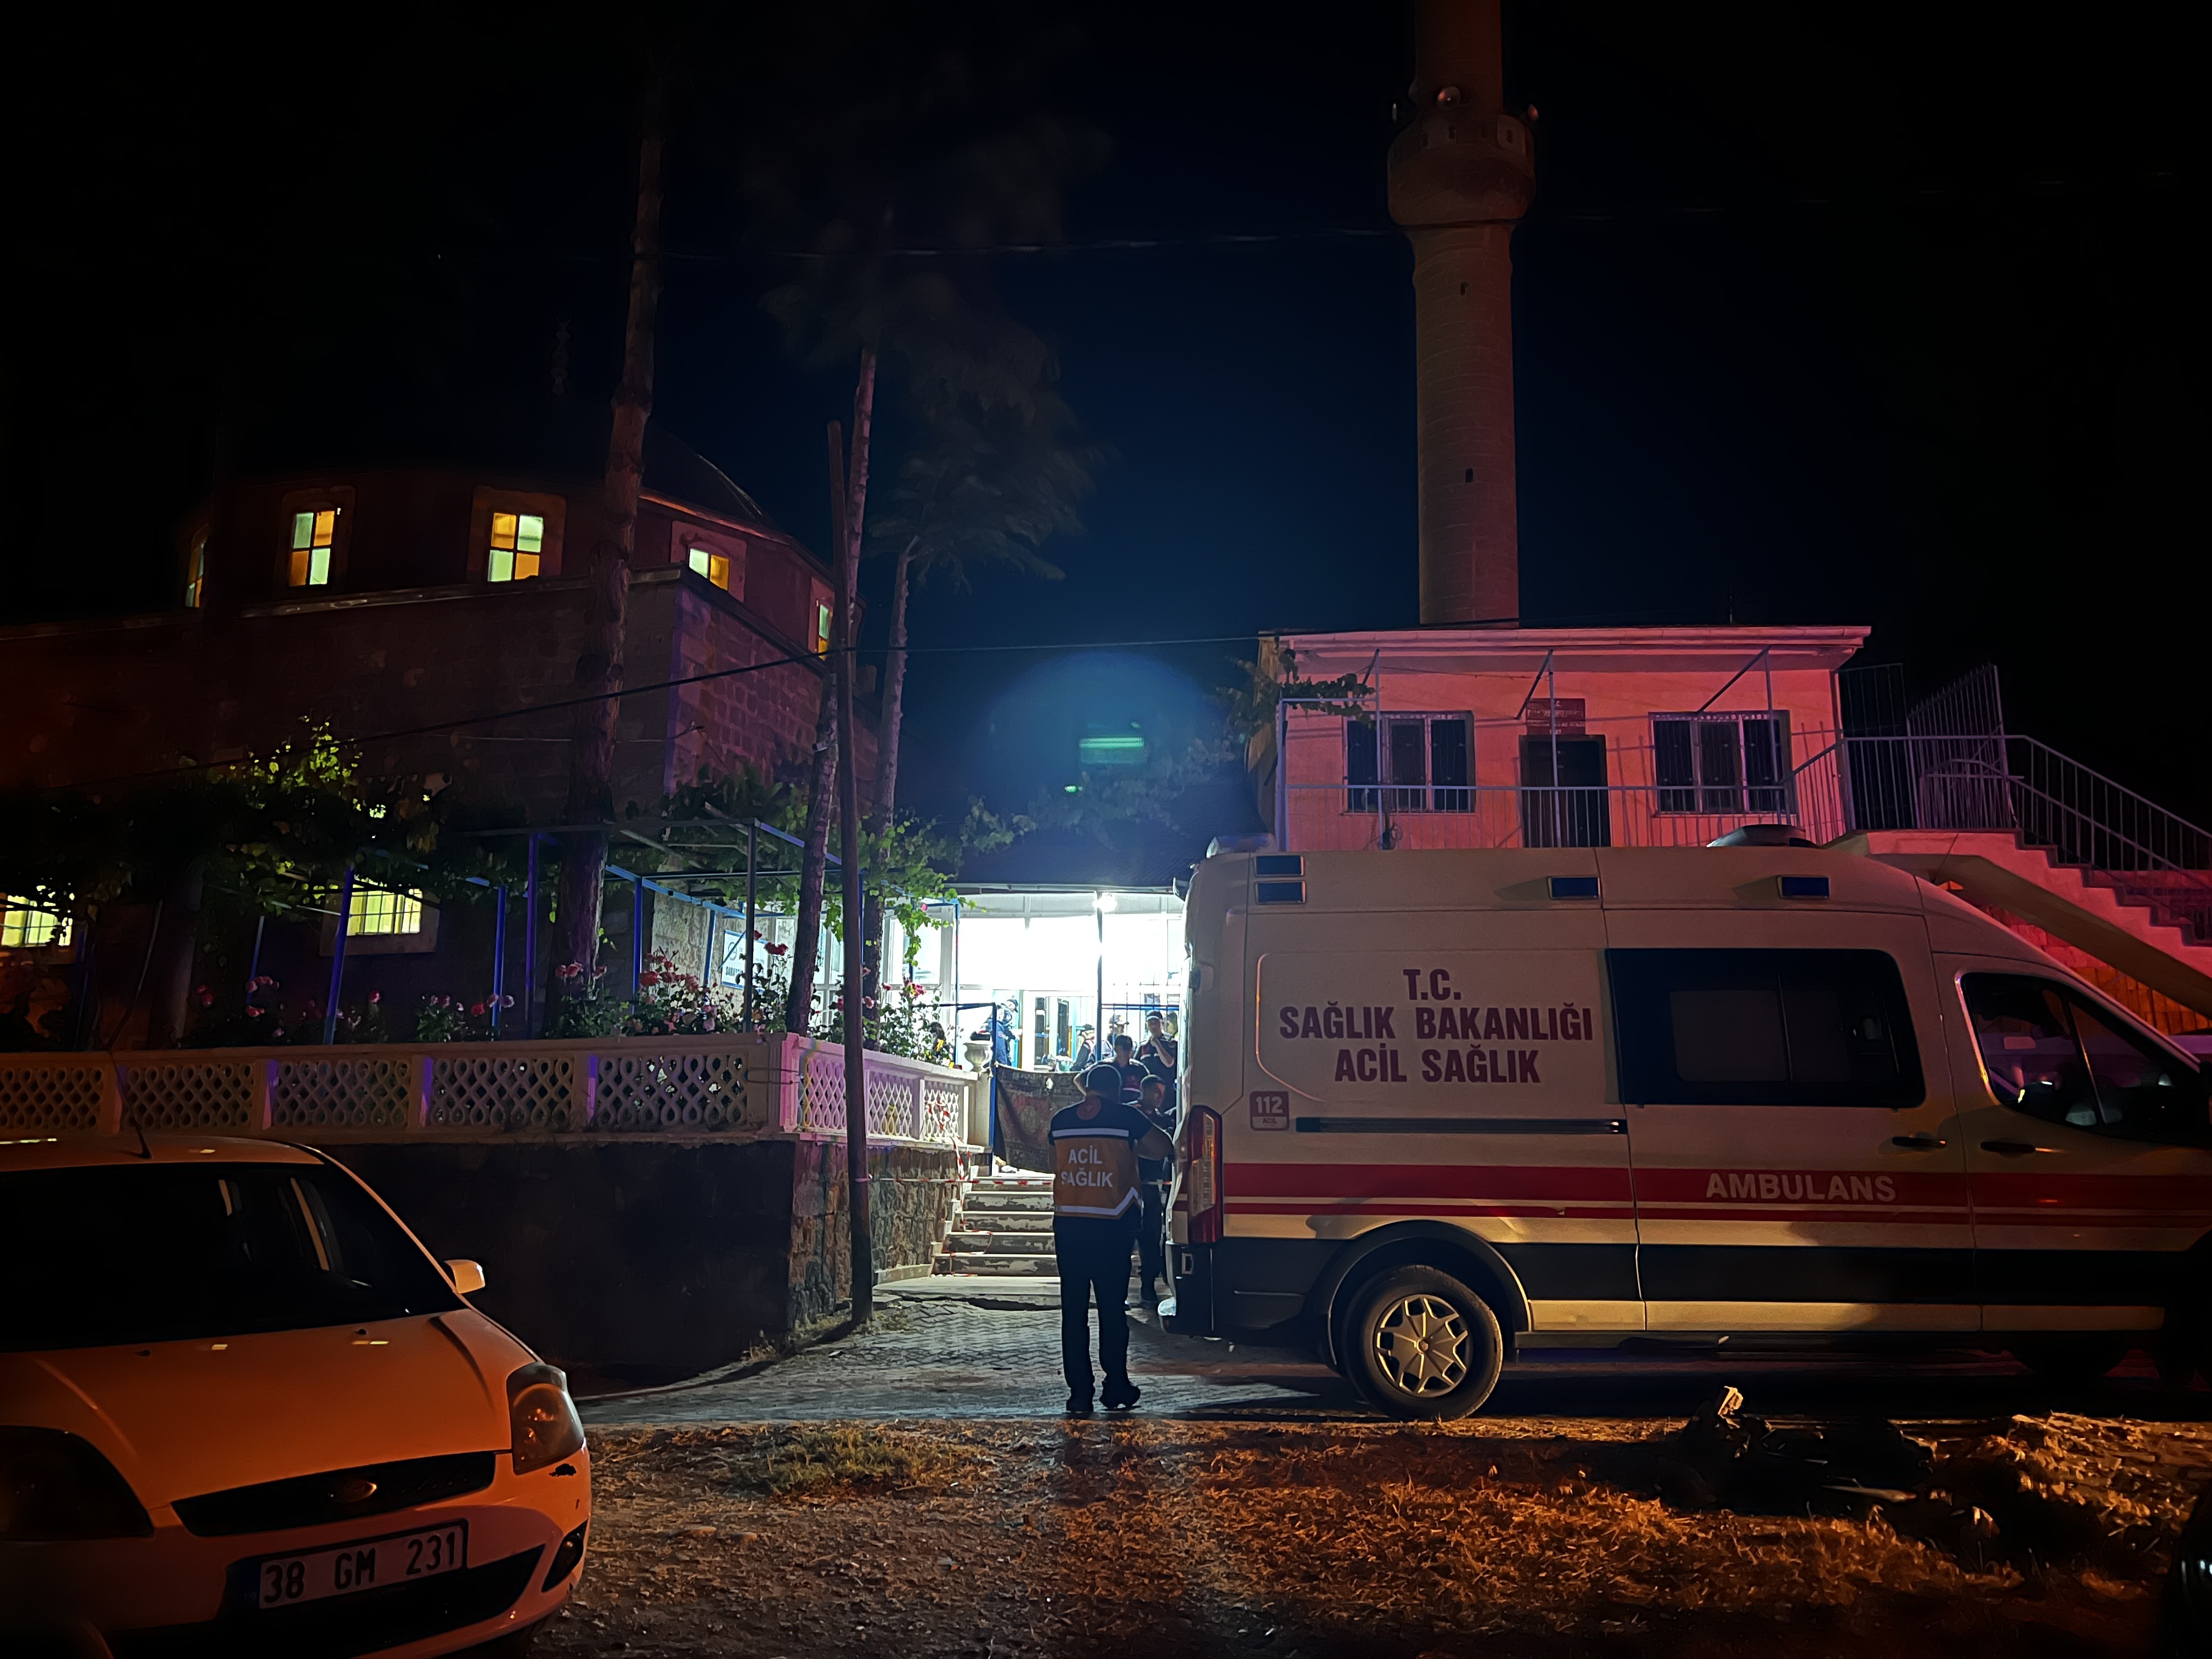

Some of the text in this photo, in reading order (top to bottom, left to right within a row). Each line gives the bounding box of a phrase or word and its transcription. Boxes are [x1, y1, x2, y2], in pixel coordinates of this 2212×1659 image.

[1403, 969, 1462, 1001] T.C.
[1279, 1001, 1593, 1041] SAĞLIK BAKANLIĞI
[1334, 1043, 1541, 1084] ACİL SAĞLIK
[1255, 1096, 1283, 1114] 112
[1069, 1144, 1103, 1164] ACİL
[1061, 1167, 1113, 1188] SAĞLIK
[1706, 1173, 1897, 1202] AMBULANS
[263, 1531, 455, 1604] 38 GM 231
